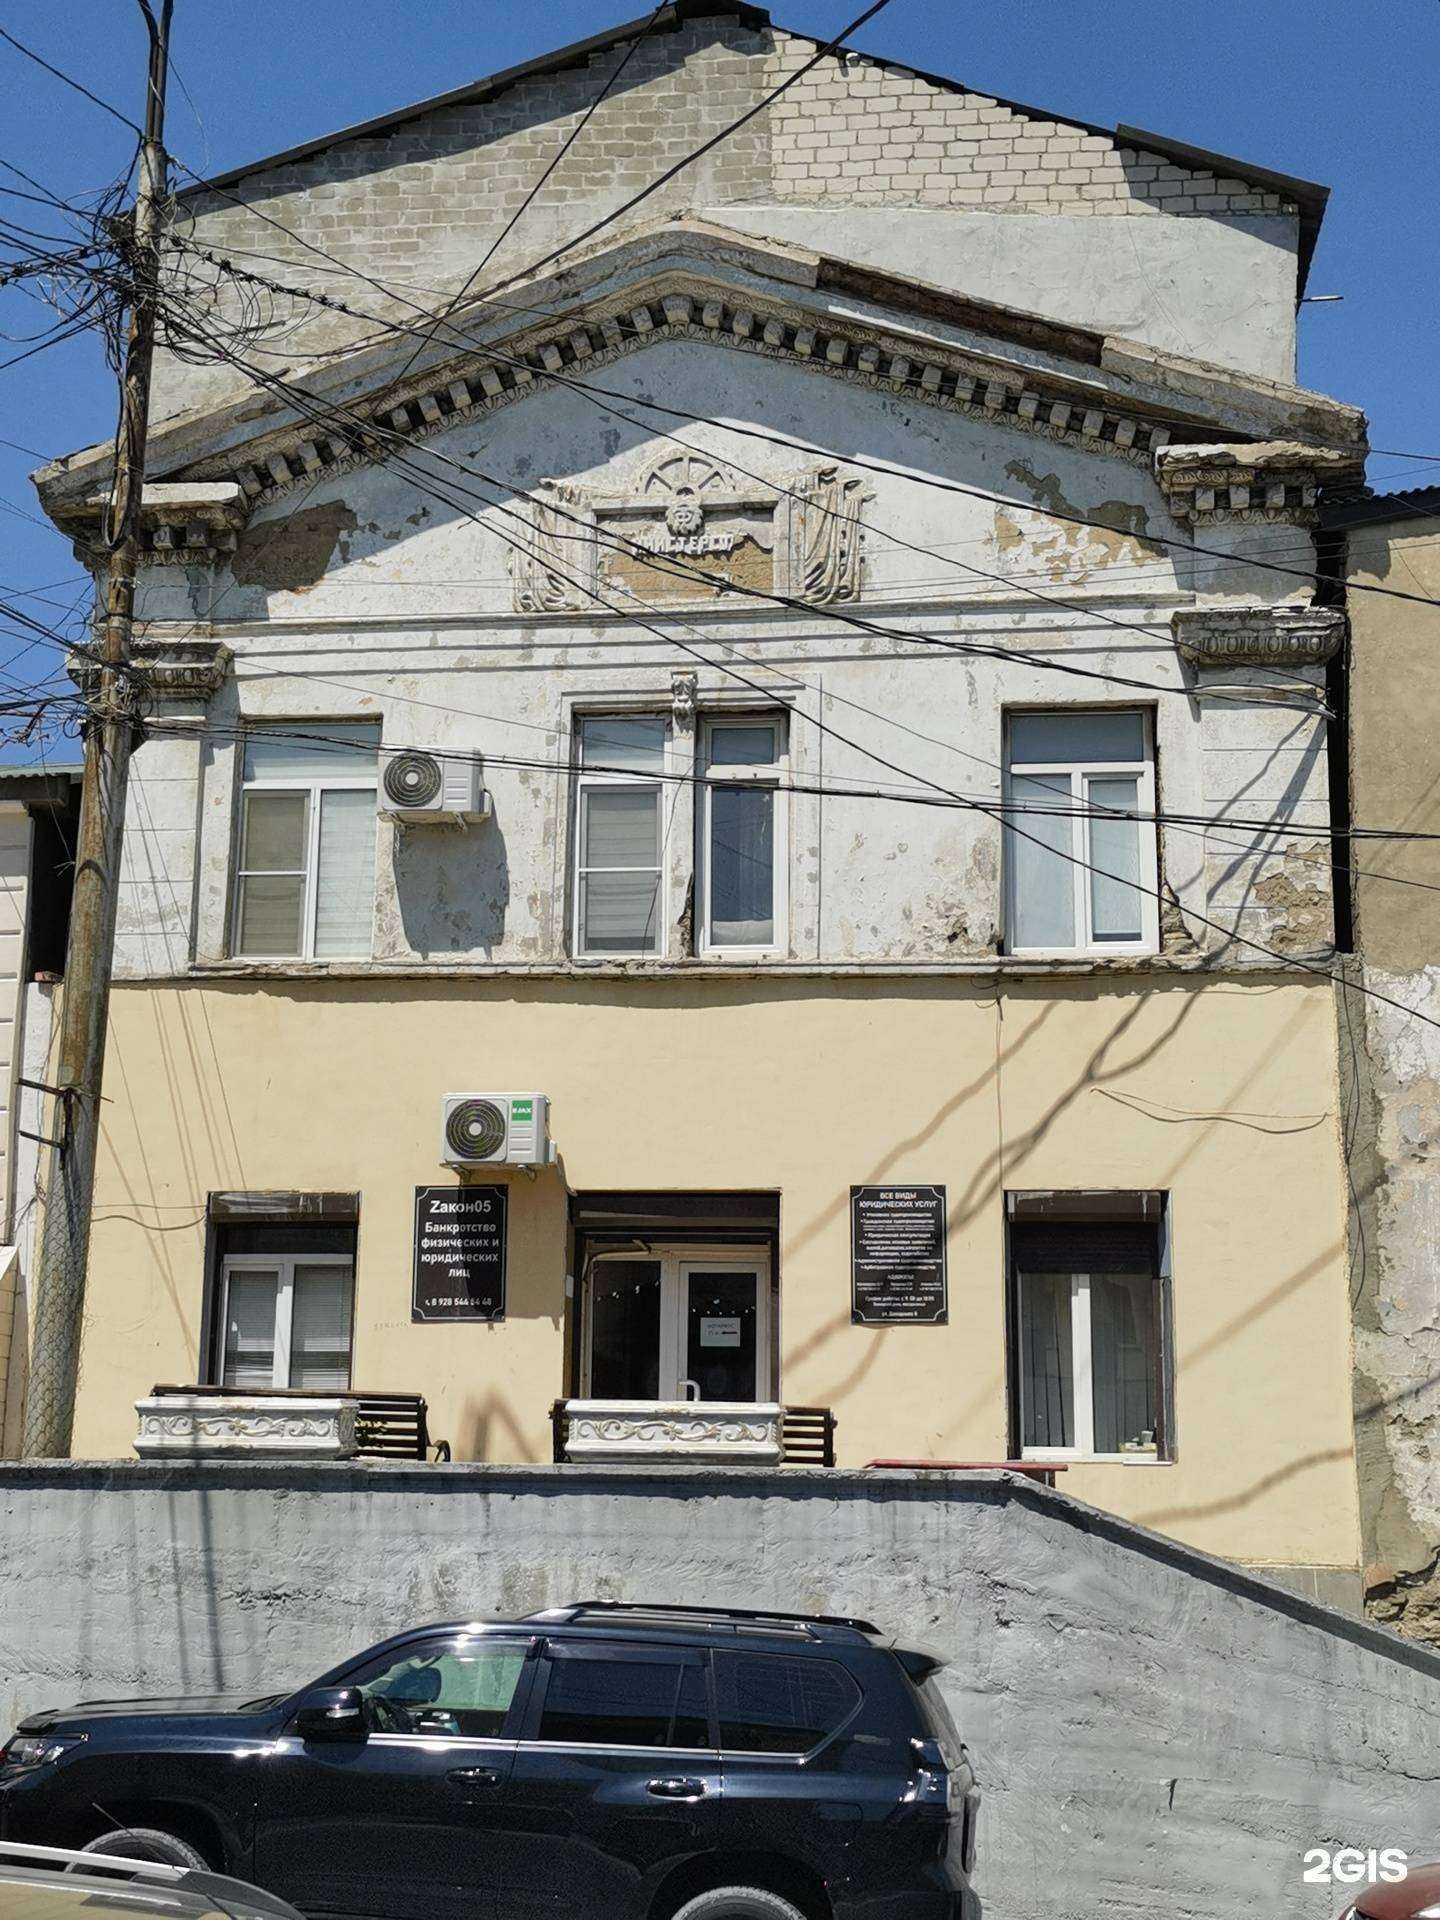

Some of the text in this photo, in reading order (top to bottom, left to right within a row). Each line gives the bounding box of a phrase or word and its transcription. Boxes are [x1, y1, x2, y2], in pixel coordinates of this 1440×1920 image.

[859, 1200, 938, 1209] ЮРИДИЧЕСКИХ УСЛУГ
[425, 1222, 496, 1235] Банкротство
[421, 1237, 500, 1249] физических и
[421, 1253, 498, 1265] юридических
[448, 1268, 470, 1278] лиц
